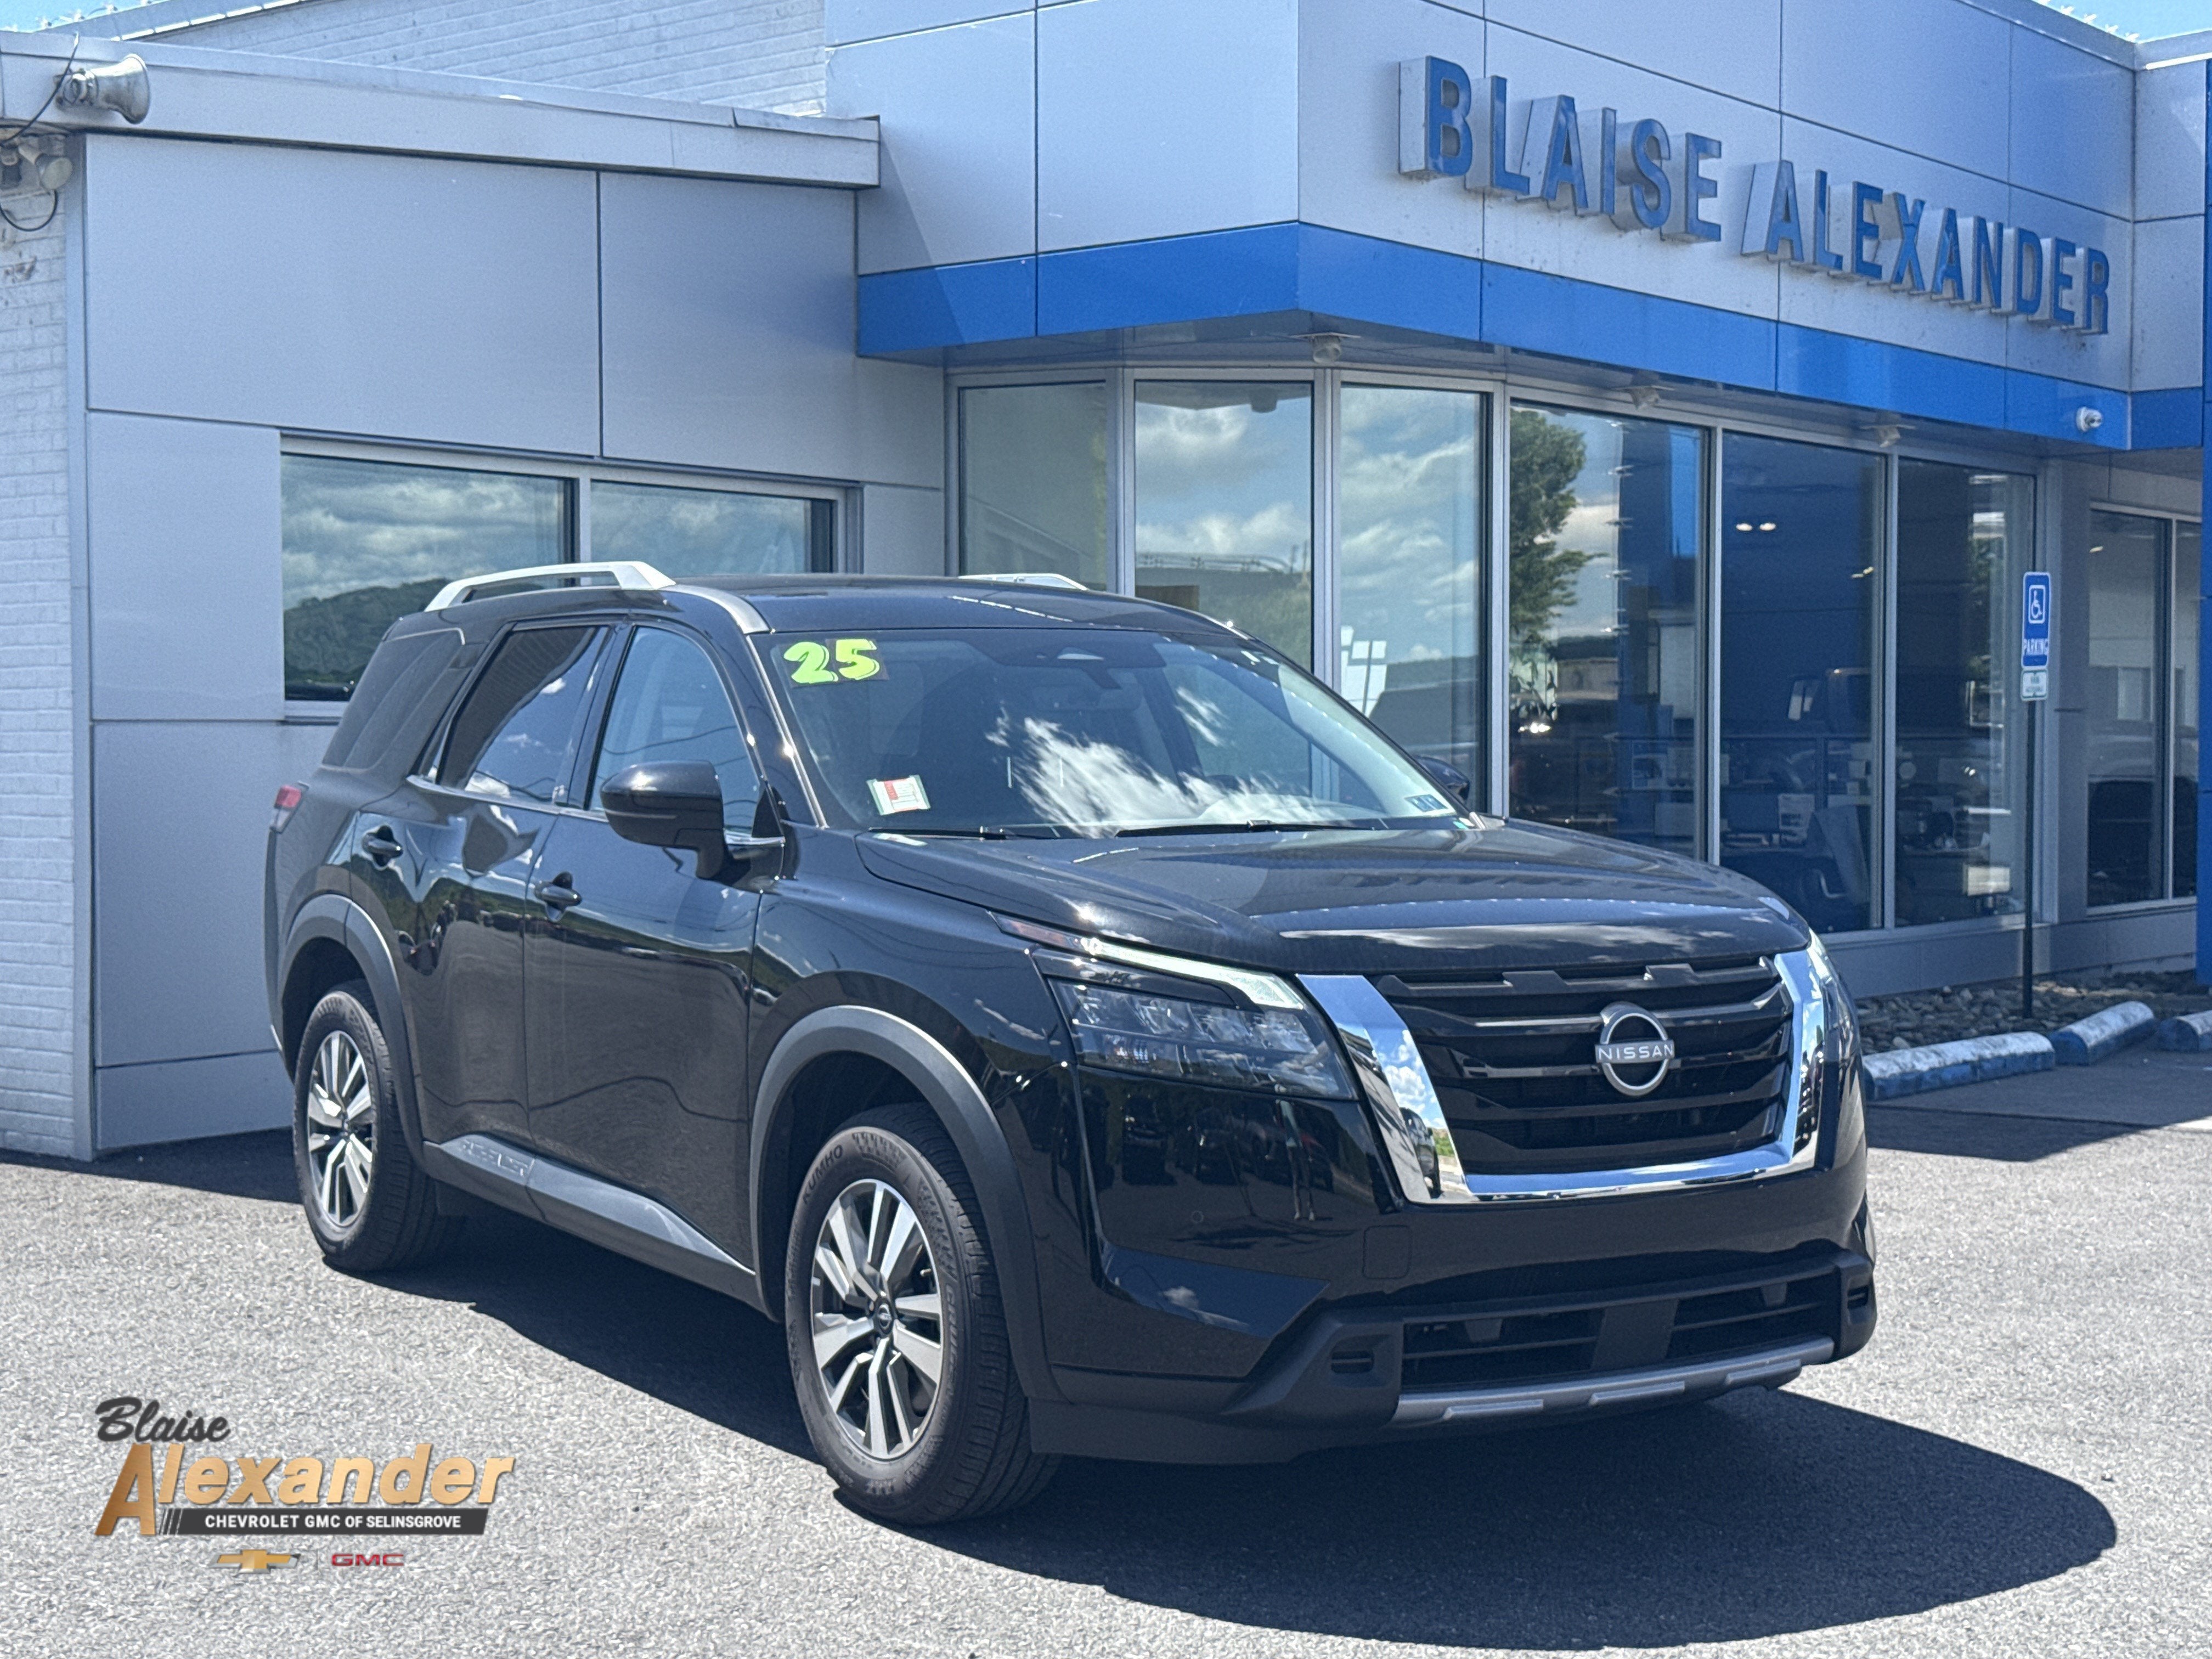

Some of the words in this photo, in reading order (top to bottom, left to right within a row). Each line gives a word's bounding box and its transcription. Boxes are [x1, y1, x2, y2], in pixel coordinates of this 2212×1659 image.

[1422, 55, 1722, 243] BLAISE
[1764, 159, 2110, 335] ALEXANDER
[783, 639, 881, 684] 25
[1598, 1043, 1674, 1060] NISSAN
[802, 1144, 843, 1205] KUMHO
